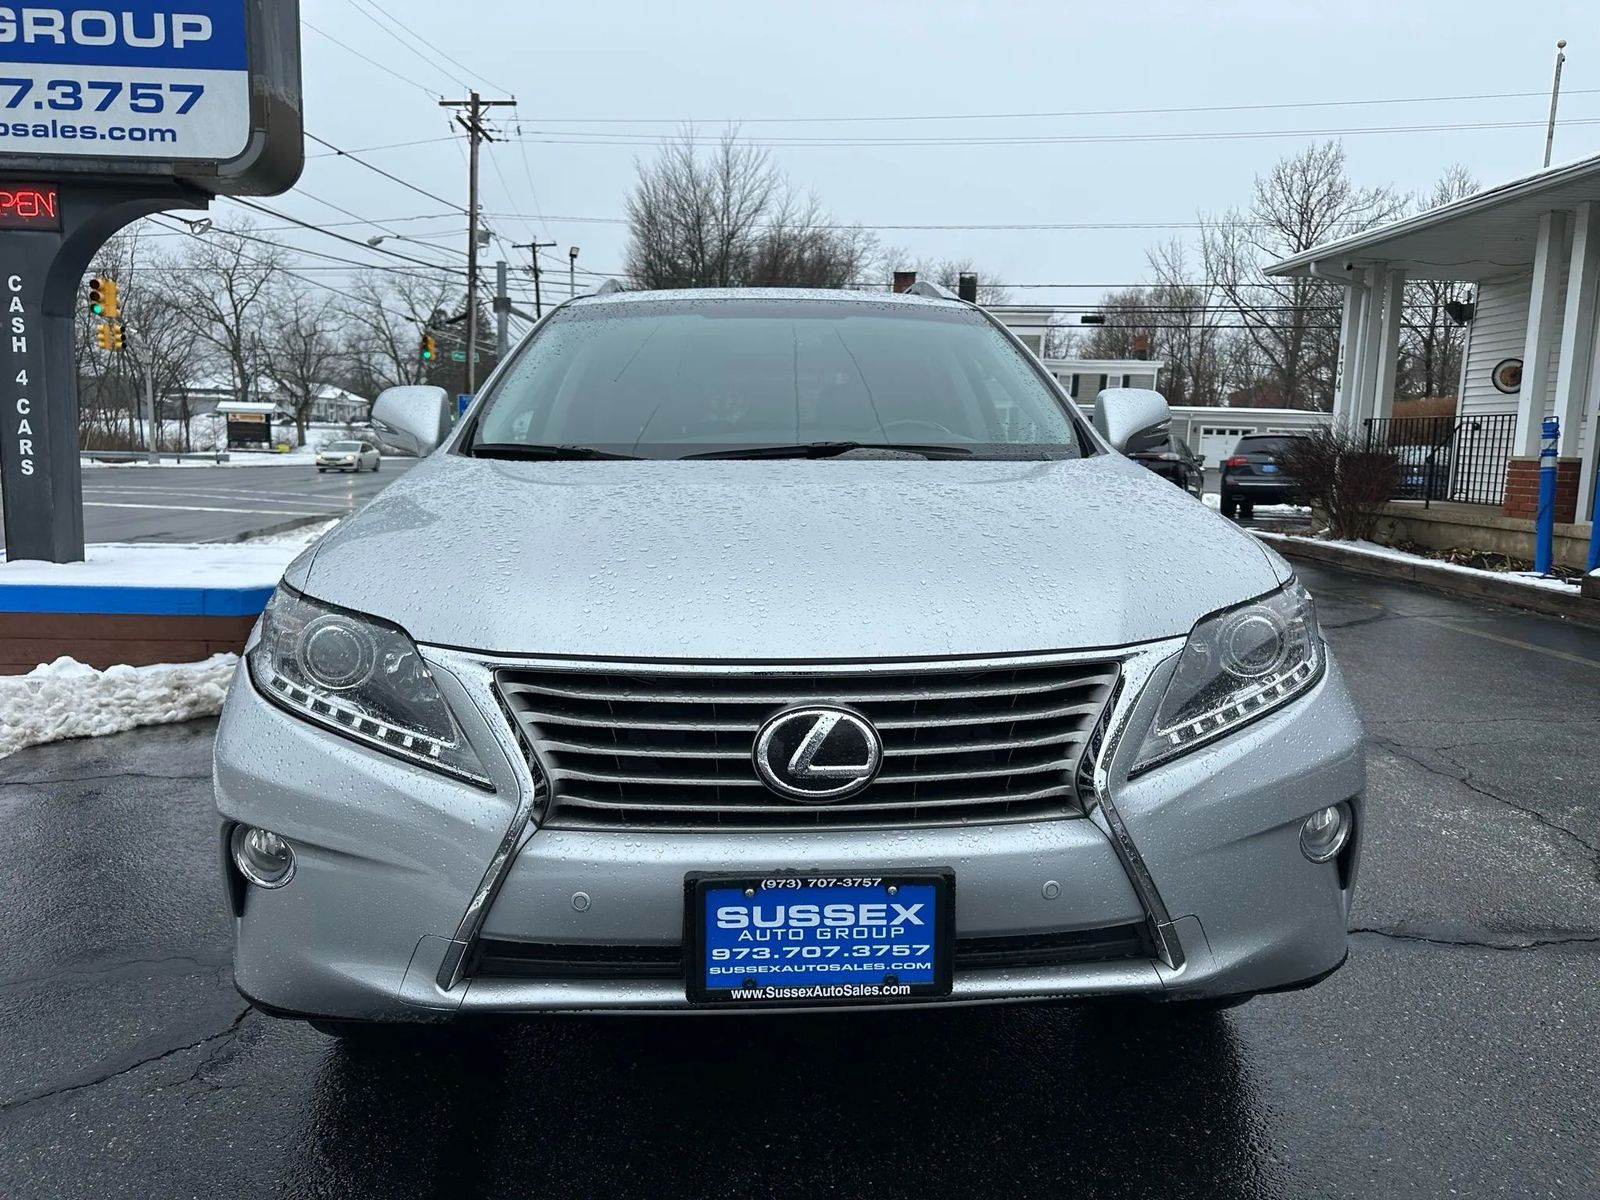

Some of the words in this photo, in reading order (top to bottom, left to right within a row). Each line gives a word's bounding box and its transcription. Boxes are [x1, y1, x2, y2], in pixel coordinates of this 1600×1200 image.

[0, 77, 205, 115] 7.3757
[8, 275, 27, 353] CASH
[1335, 344, 1344, 392] 134
[15, 369, 29, 386] 4
[16, 398, 34, 476] CARS
[760, 879, 802, 890] (973)
[807, 878, 882, 888] 707-3757
[716, 903, 925, 929] SUSSEX
[737, 928, 804, 942] AUTO
[816, 927, 905, 940] GROUP
[711, 944, 931, 961] 973.707.3757
[709, 962, 932, 975] SUSSEXAUTOSALES.COM
[730, 983, 911, 1000] www.SussexAutoSales.com
